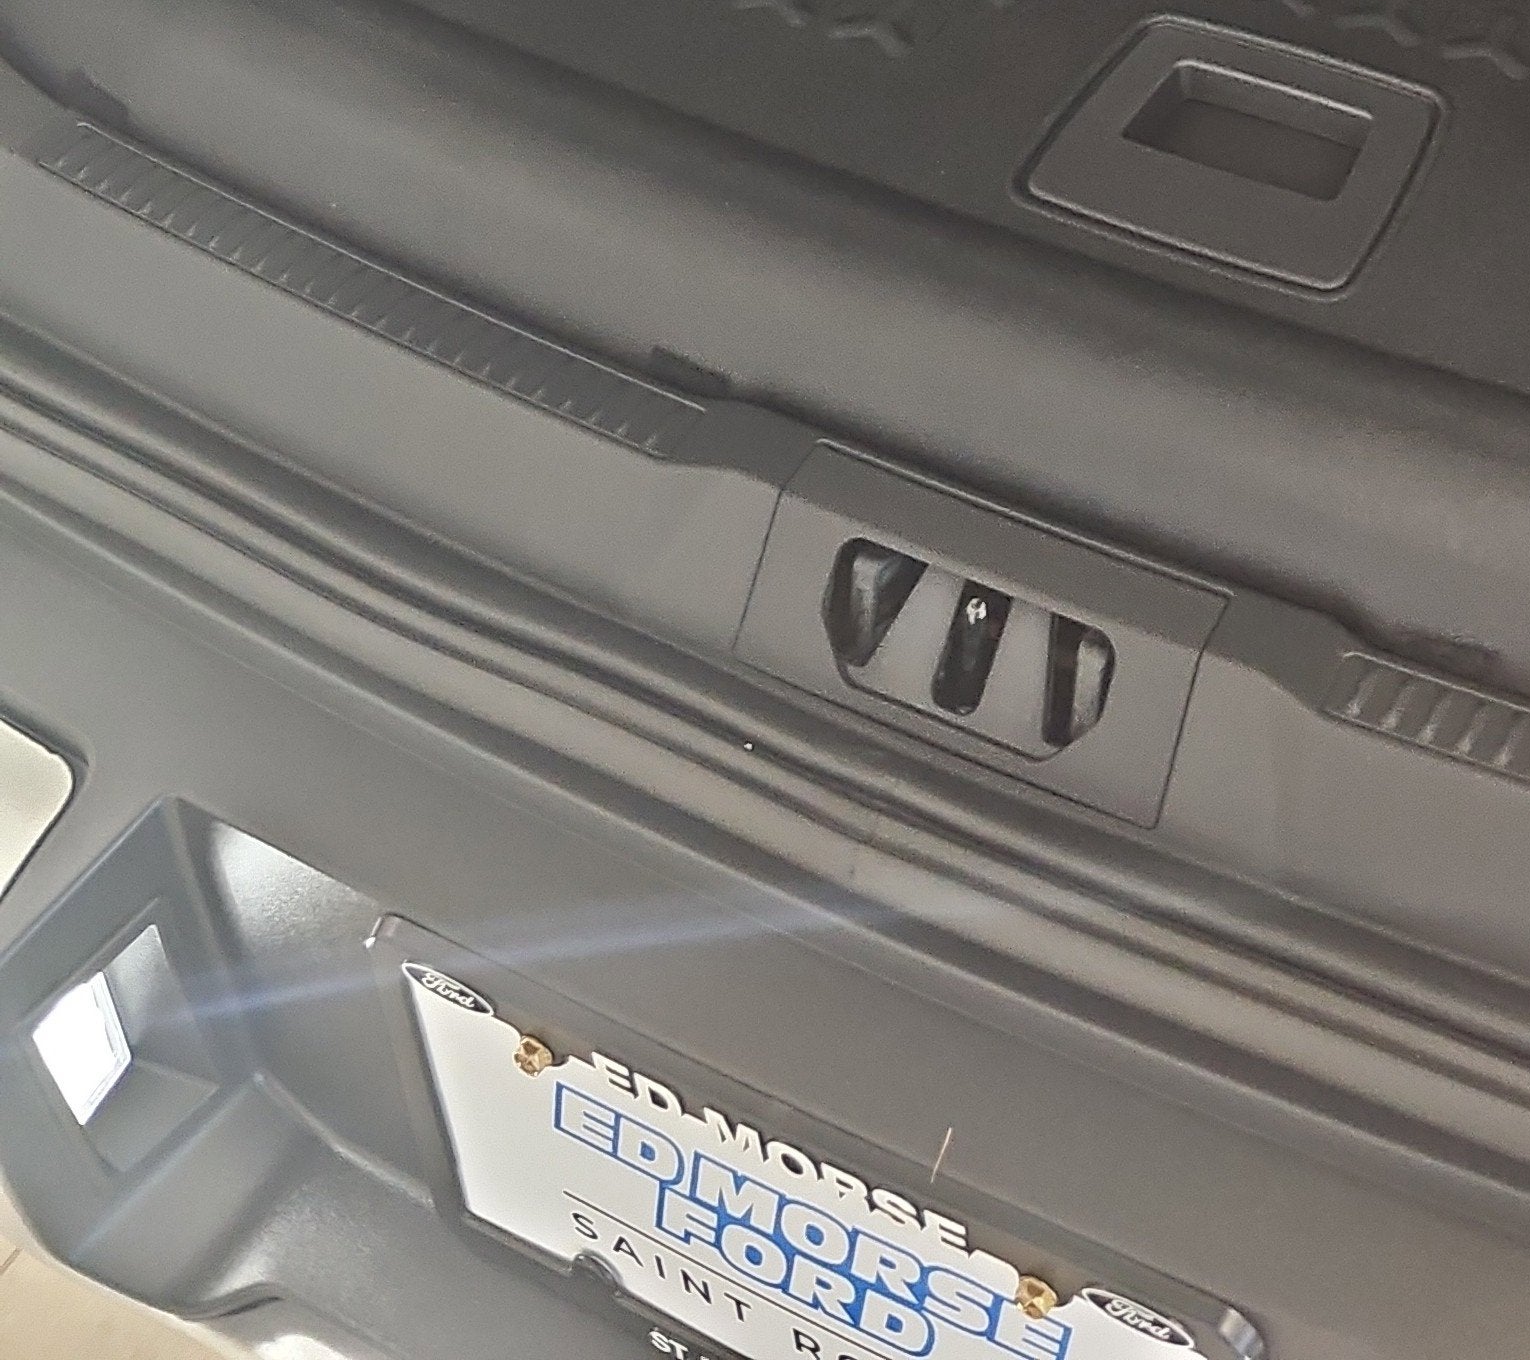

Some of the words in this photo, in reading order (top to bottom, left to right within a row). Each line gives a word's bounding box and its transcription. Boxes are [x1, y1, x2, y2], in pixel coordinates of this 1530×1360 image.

[421, 972, 476, 1008] Ford
[554, 1080, 685, 1186] ED
[688, 1150, 1074, 1360] MORSE
[591, 1050, 684, 1117] ED
[703, 1106, 971, 1258] MORSE
[572, 1212, 752, 1323] SAINT
[655, 1179, 935, 1358] FORD
[1105, 1298, 1171, 1340] Ford
